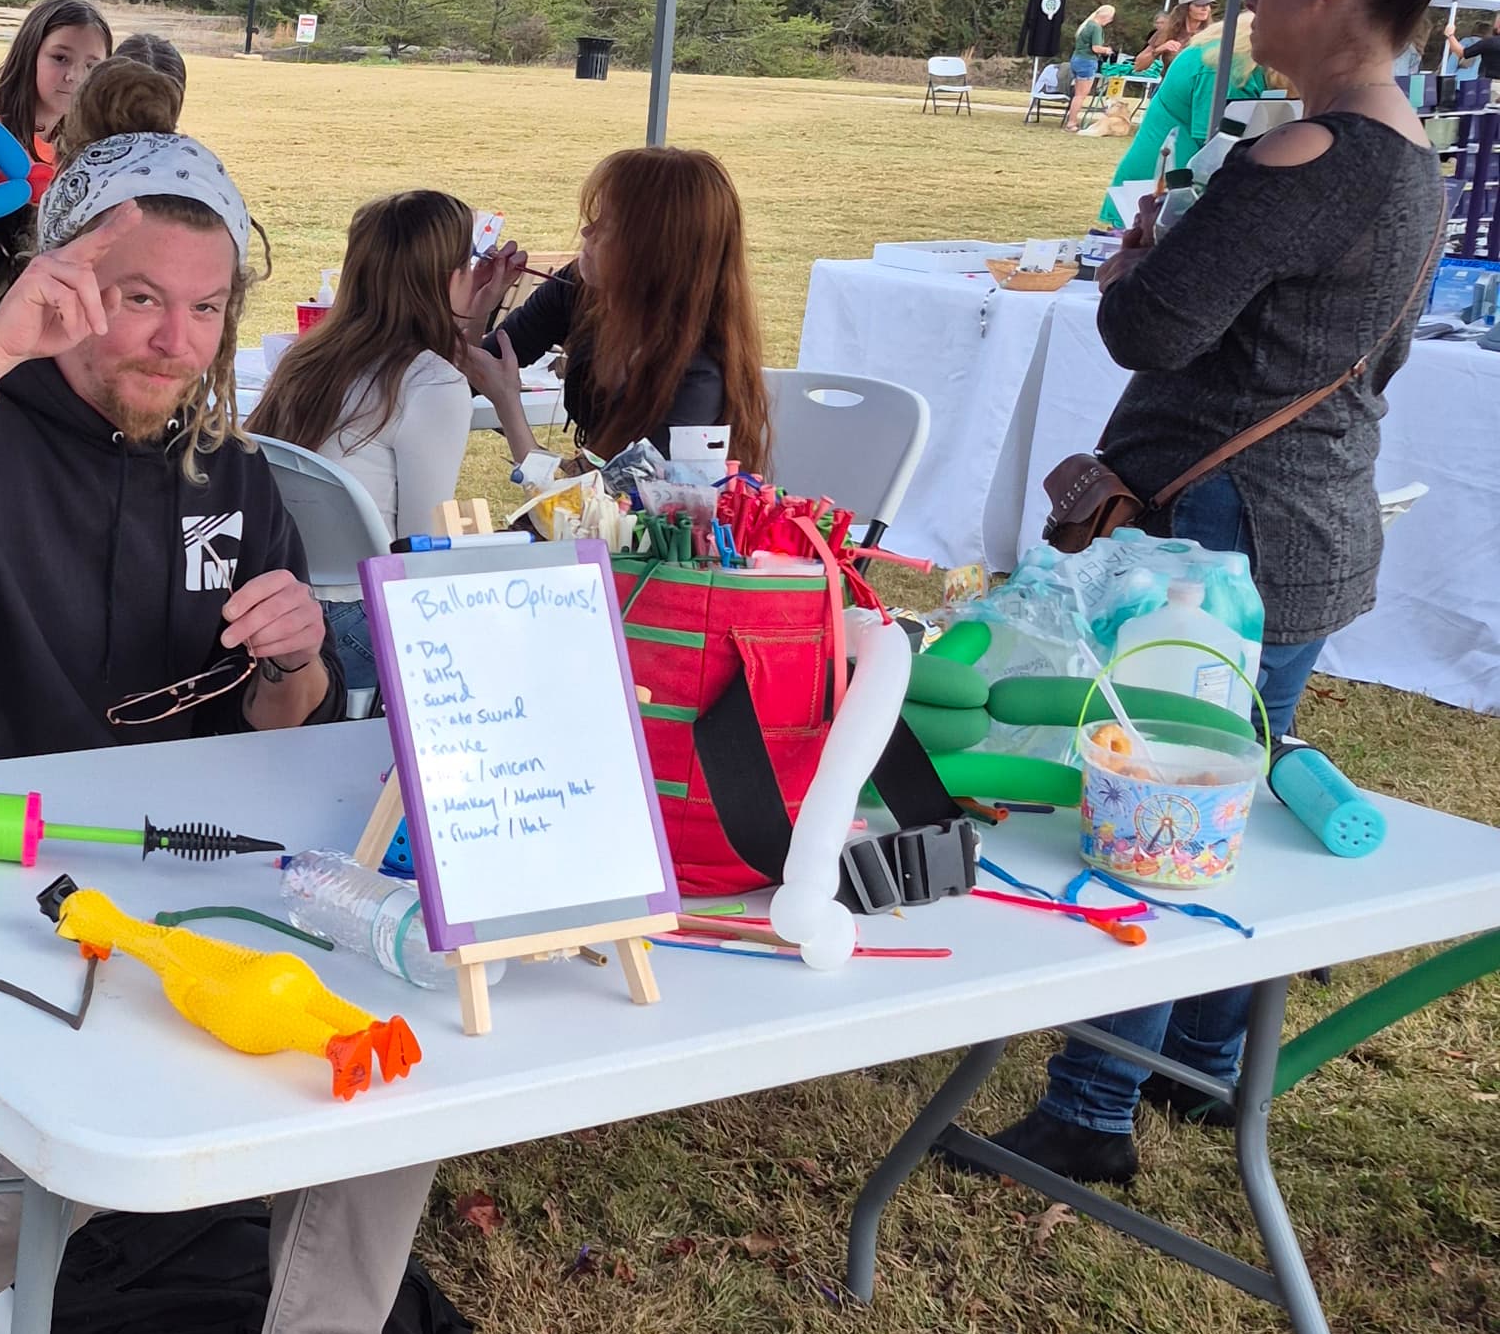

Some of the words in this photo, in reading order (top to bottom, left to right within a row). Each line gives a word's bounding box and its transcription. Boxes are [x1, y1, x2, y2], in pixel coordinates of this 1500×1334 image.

[411, 583, 500, 621] Balloon
[416, 640, 453, 669] Dog
[488, 757, 545, 779] unicorn
[444, 797, 500, 821] Monkey
[514, 786, 566, 809] Monkey
[567, 778, 596, 796] Hat
[518, 815, 553, 836] Hat
